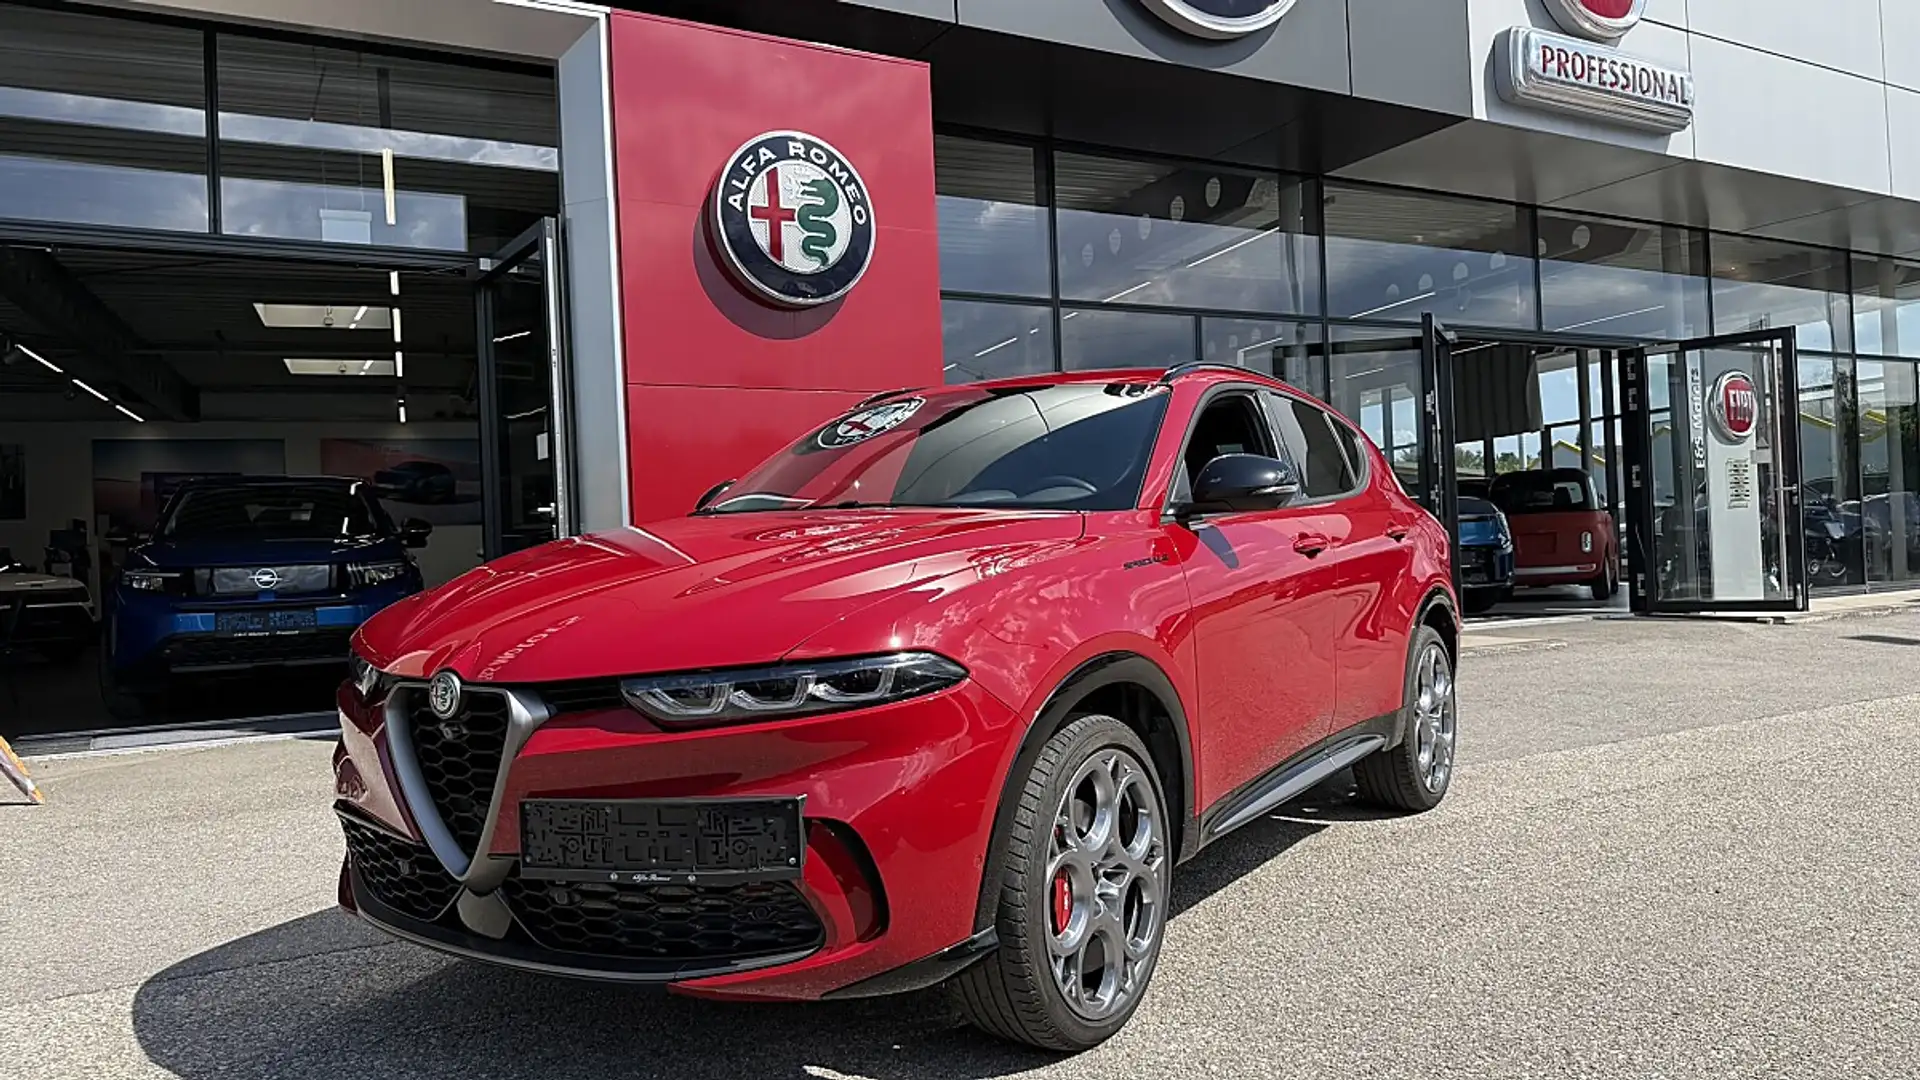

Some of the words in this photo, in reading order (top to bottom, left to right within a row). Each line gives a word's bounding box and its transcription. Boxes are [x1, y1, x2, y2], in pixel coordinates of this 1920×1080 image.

[1541, 45, 1688, 104] PROFESSIONAL
[728, 147, 777, 212] ALFA
[788, 141, 866, 225] ROMEO
[1728, 389, 1752, 423] FIAT
